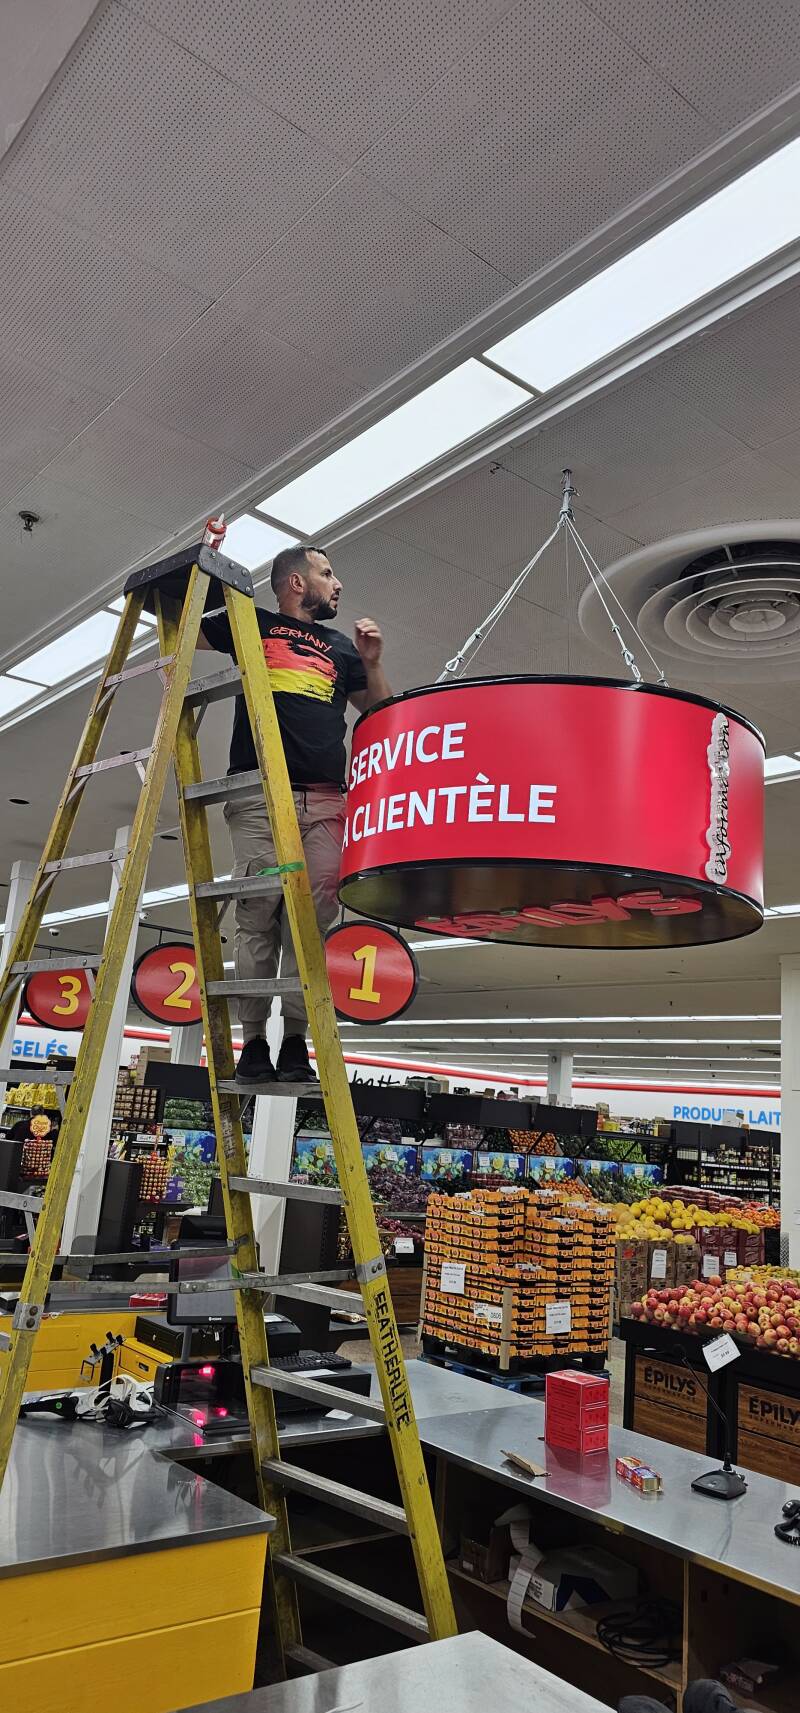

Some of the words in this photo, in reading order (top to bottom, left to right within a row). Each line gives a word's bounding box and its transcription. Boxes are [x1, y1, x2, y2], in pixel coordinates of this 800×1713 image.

[269, 626, 333, 653] GERMANY
[350, 722, 467, 791] SERVICE
[352, 772, 557, 842] CLIENTÈLE
[52, 975, 82, 1016] 3
[163, 961, 196, 1010] 2
[349, 944, 381, 1004] 1
[12, 1039, 68, 1058] GELÉS
[673, 1105, 744, 1122] PRODU
